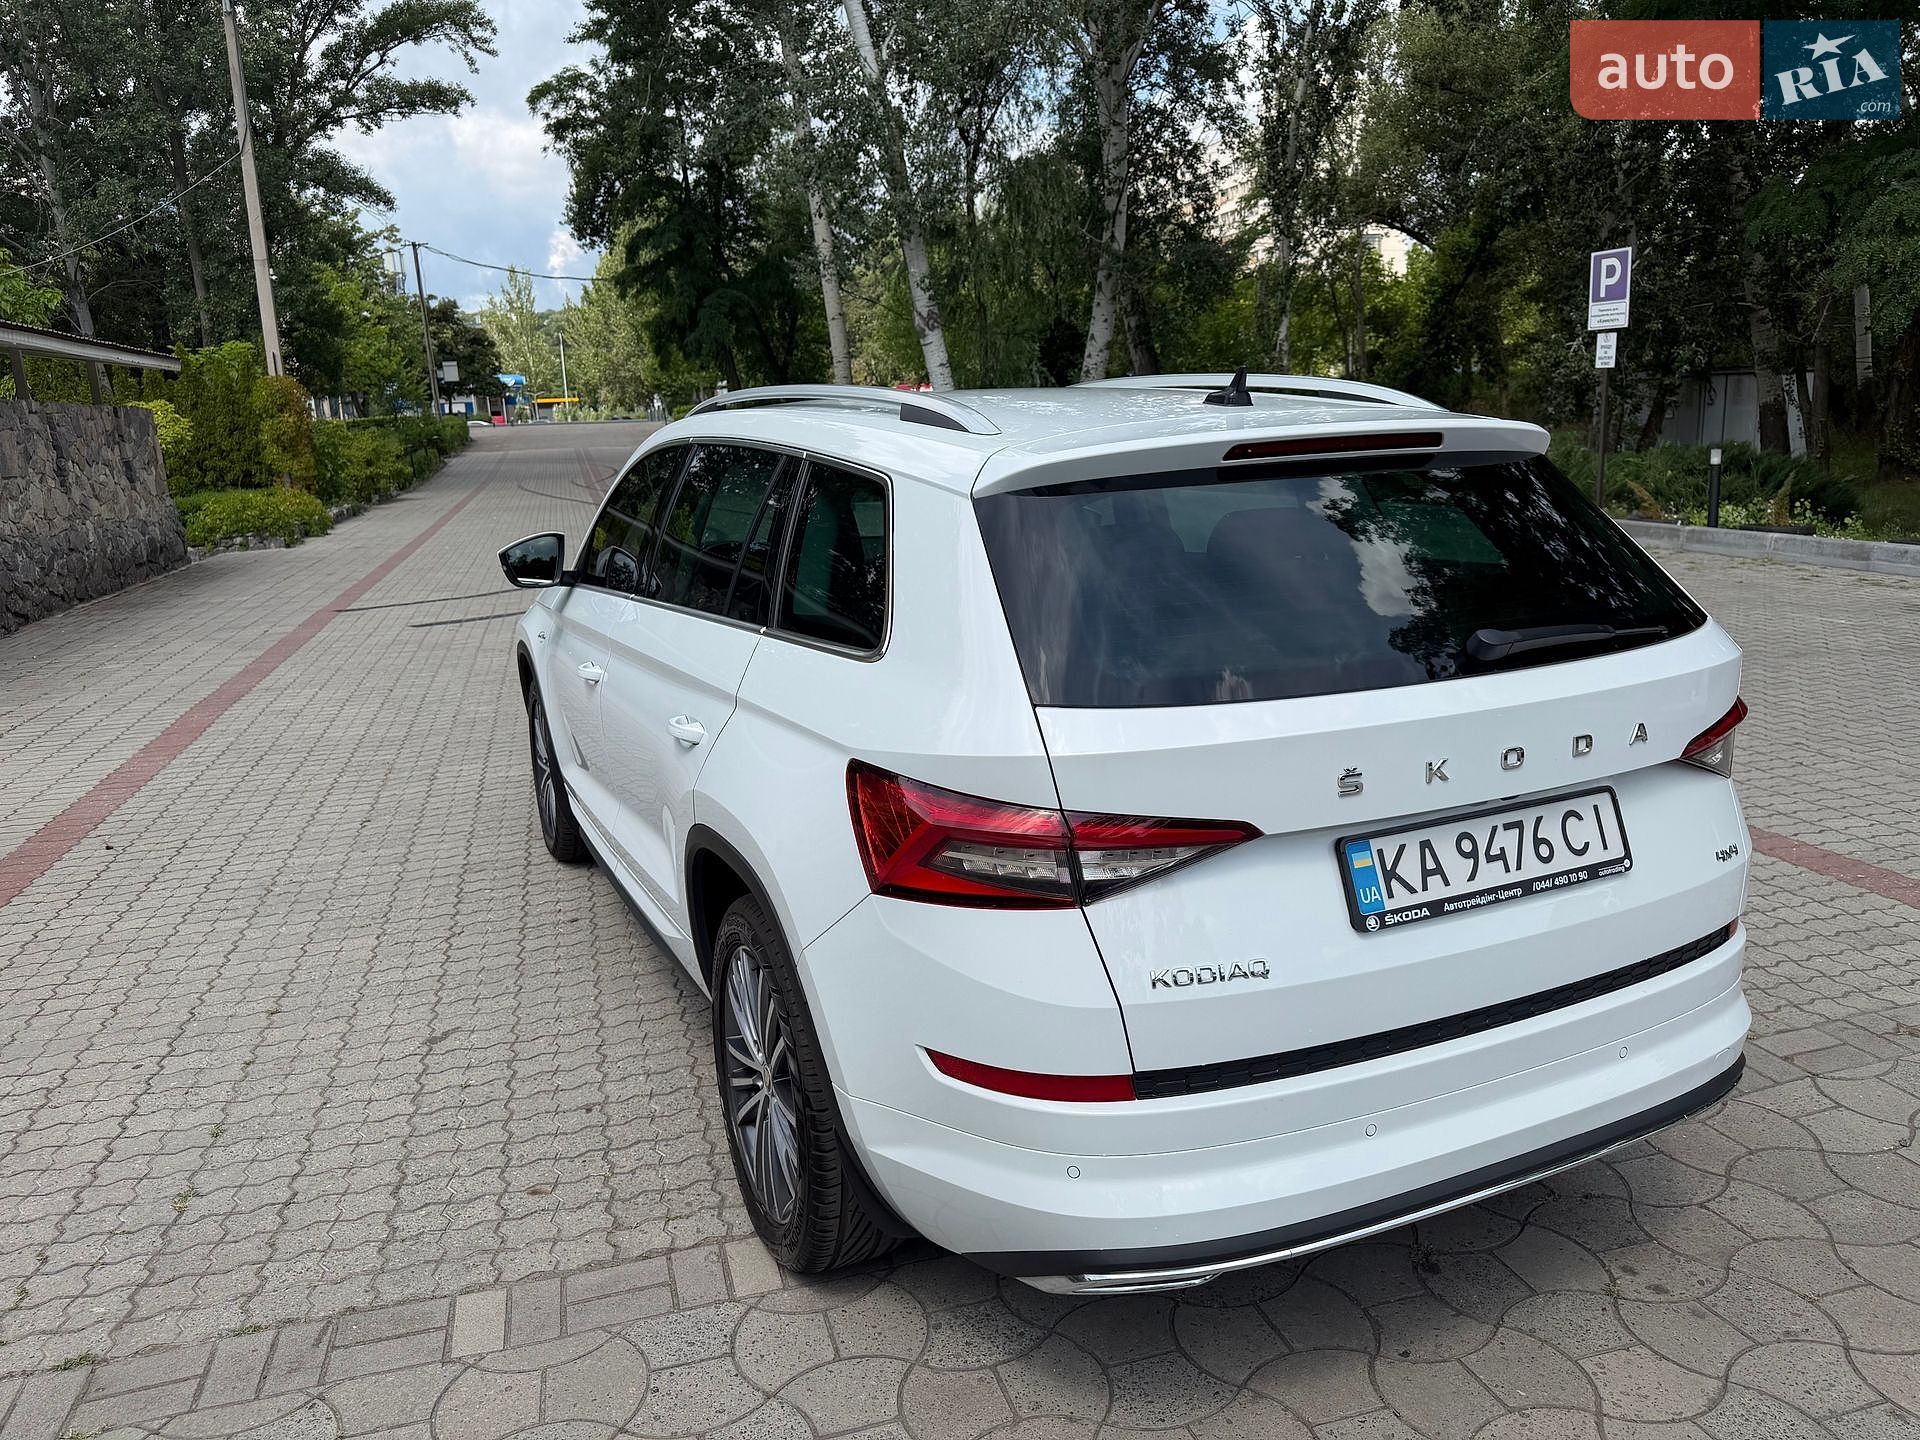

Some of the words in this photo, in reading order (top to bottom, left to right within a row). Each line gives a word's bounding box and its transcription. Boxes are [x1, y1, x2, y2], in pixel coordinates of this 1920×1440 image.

[1600, 257, 1622, 298] P
[1376, 838, 1451, 899] KA
[1455, 815, 1555, 882] 9476
[1560, 804, 1609, 857] CI
[1554, 874, 1569, 886] 490
[1569, 872, 1578, 883] 10
[1578, 870, 1588, 880] 90
[1360, 886, 1382, 904] UA
[1384, 907, 1431, 926] ŠKODA
[1149, 958, 1270, 989] KODIAQ
